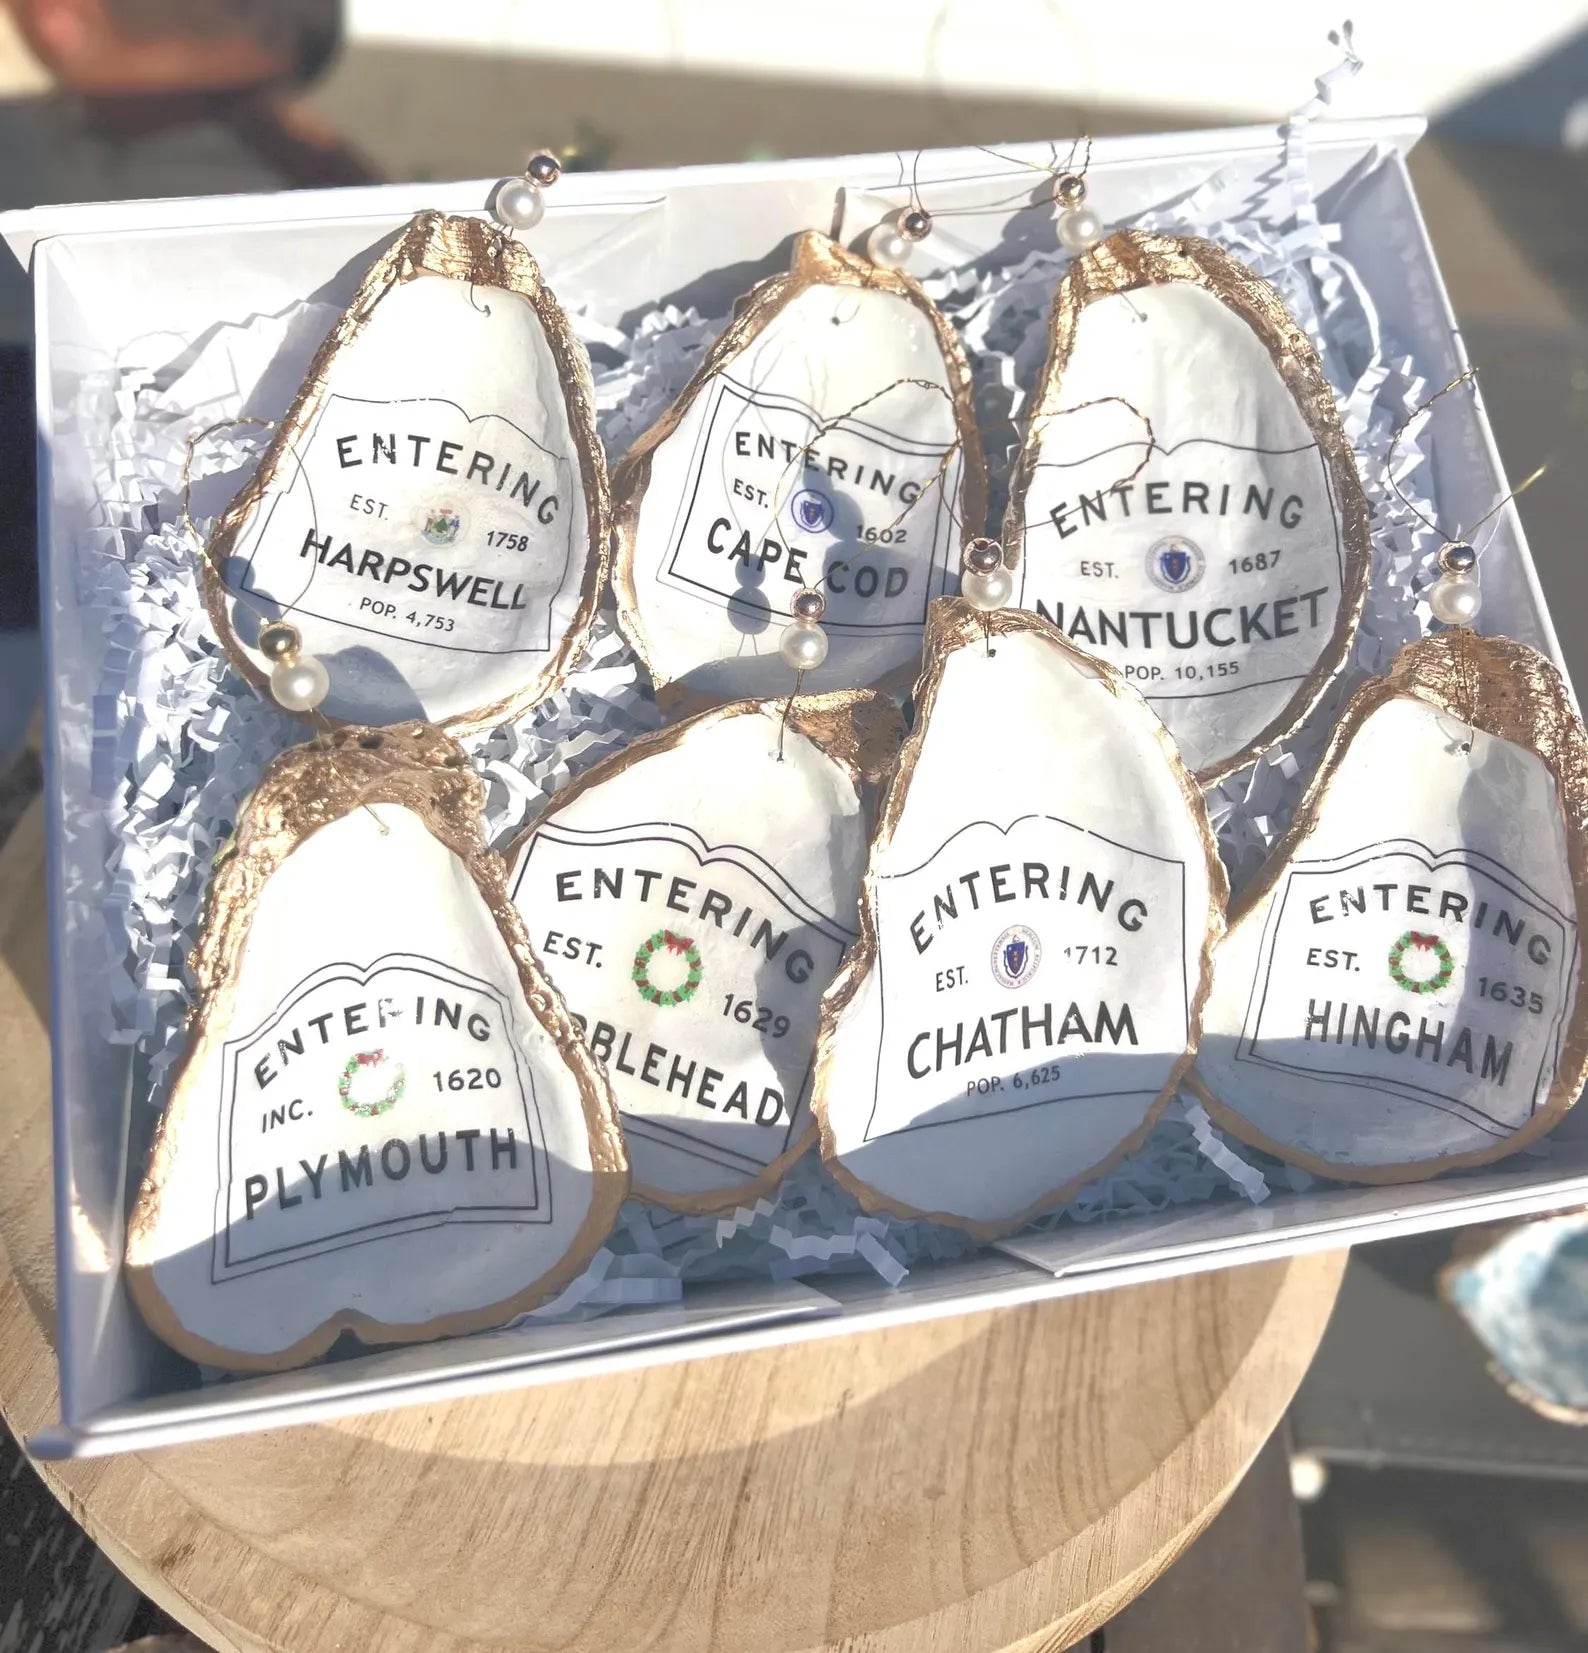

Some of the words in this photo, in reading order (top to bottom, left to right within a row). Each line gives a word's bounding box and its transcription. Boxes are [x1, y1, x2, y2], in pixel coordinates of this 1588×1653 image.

[336, 433, 560, 525] ENTERING
[735, 432, 921, 505] ENTERING
[349, 493, 389, 521] EST.
[486, 530, 529, 552] 1758
[733, 478, 769, 509] EST.
[856, 525, 907, 544] 1602
[1050, 481, 1304, 539] ENTERING
[300, 528, 527, 610] HARPSWELL
[707, 517, 808, 584] CAPE
[826, 561, 909, 598] COD
[1080, 561, 1119, 579] EST.
[1228, 550, 1281, 575] 1687
[359, 596, 397, 619] POP.
[406, 609, 455, 632] 4,753
[1036, 587, 1328, 649] NANTUCKET
[1125, 665, 1164, 681] POP.
[1175, 661, 1240, 682] 10,155
[556, 868, 814, 984] ENTERING
[909, 862, 1148, 955] ENTERING
[1309, 883, 1551, 966] ENTERING
[543, 930, 603, 969] EST.
[723, 993, 791, 1039] 1629
[936, 965, 969, 992] EST.
[1306, 948, 1360, 972] EST.
[1478, 976, 1544, 1015] 1635
[569, 1011, 784, 1127] BLEHEAD
[907, 1001, 1139, 1080] CHATHAM
[1304, 999, 1513, 1087] HINGHAM
[261, 1098, 313, 1134] INC.
[433, 1068, 502, 1093] 1620
[967, 1075, 1004, 1097] POP.
[1013, 1065, 1061, 1090] 6,625
[245, 1127, 518, 1221] PLYMOUTH
